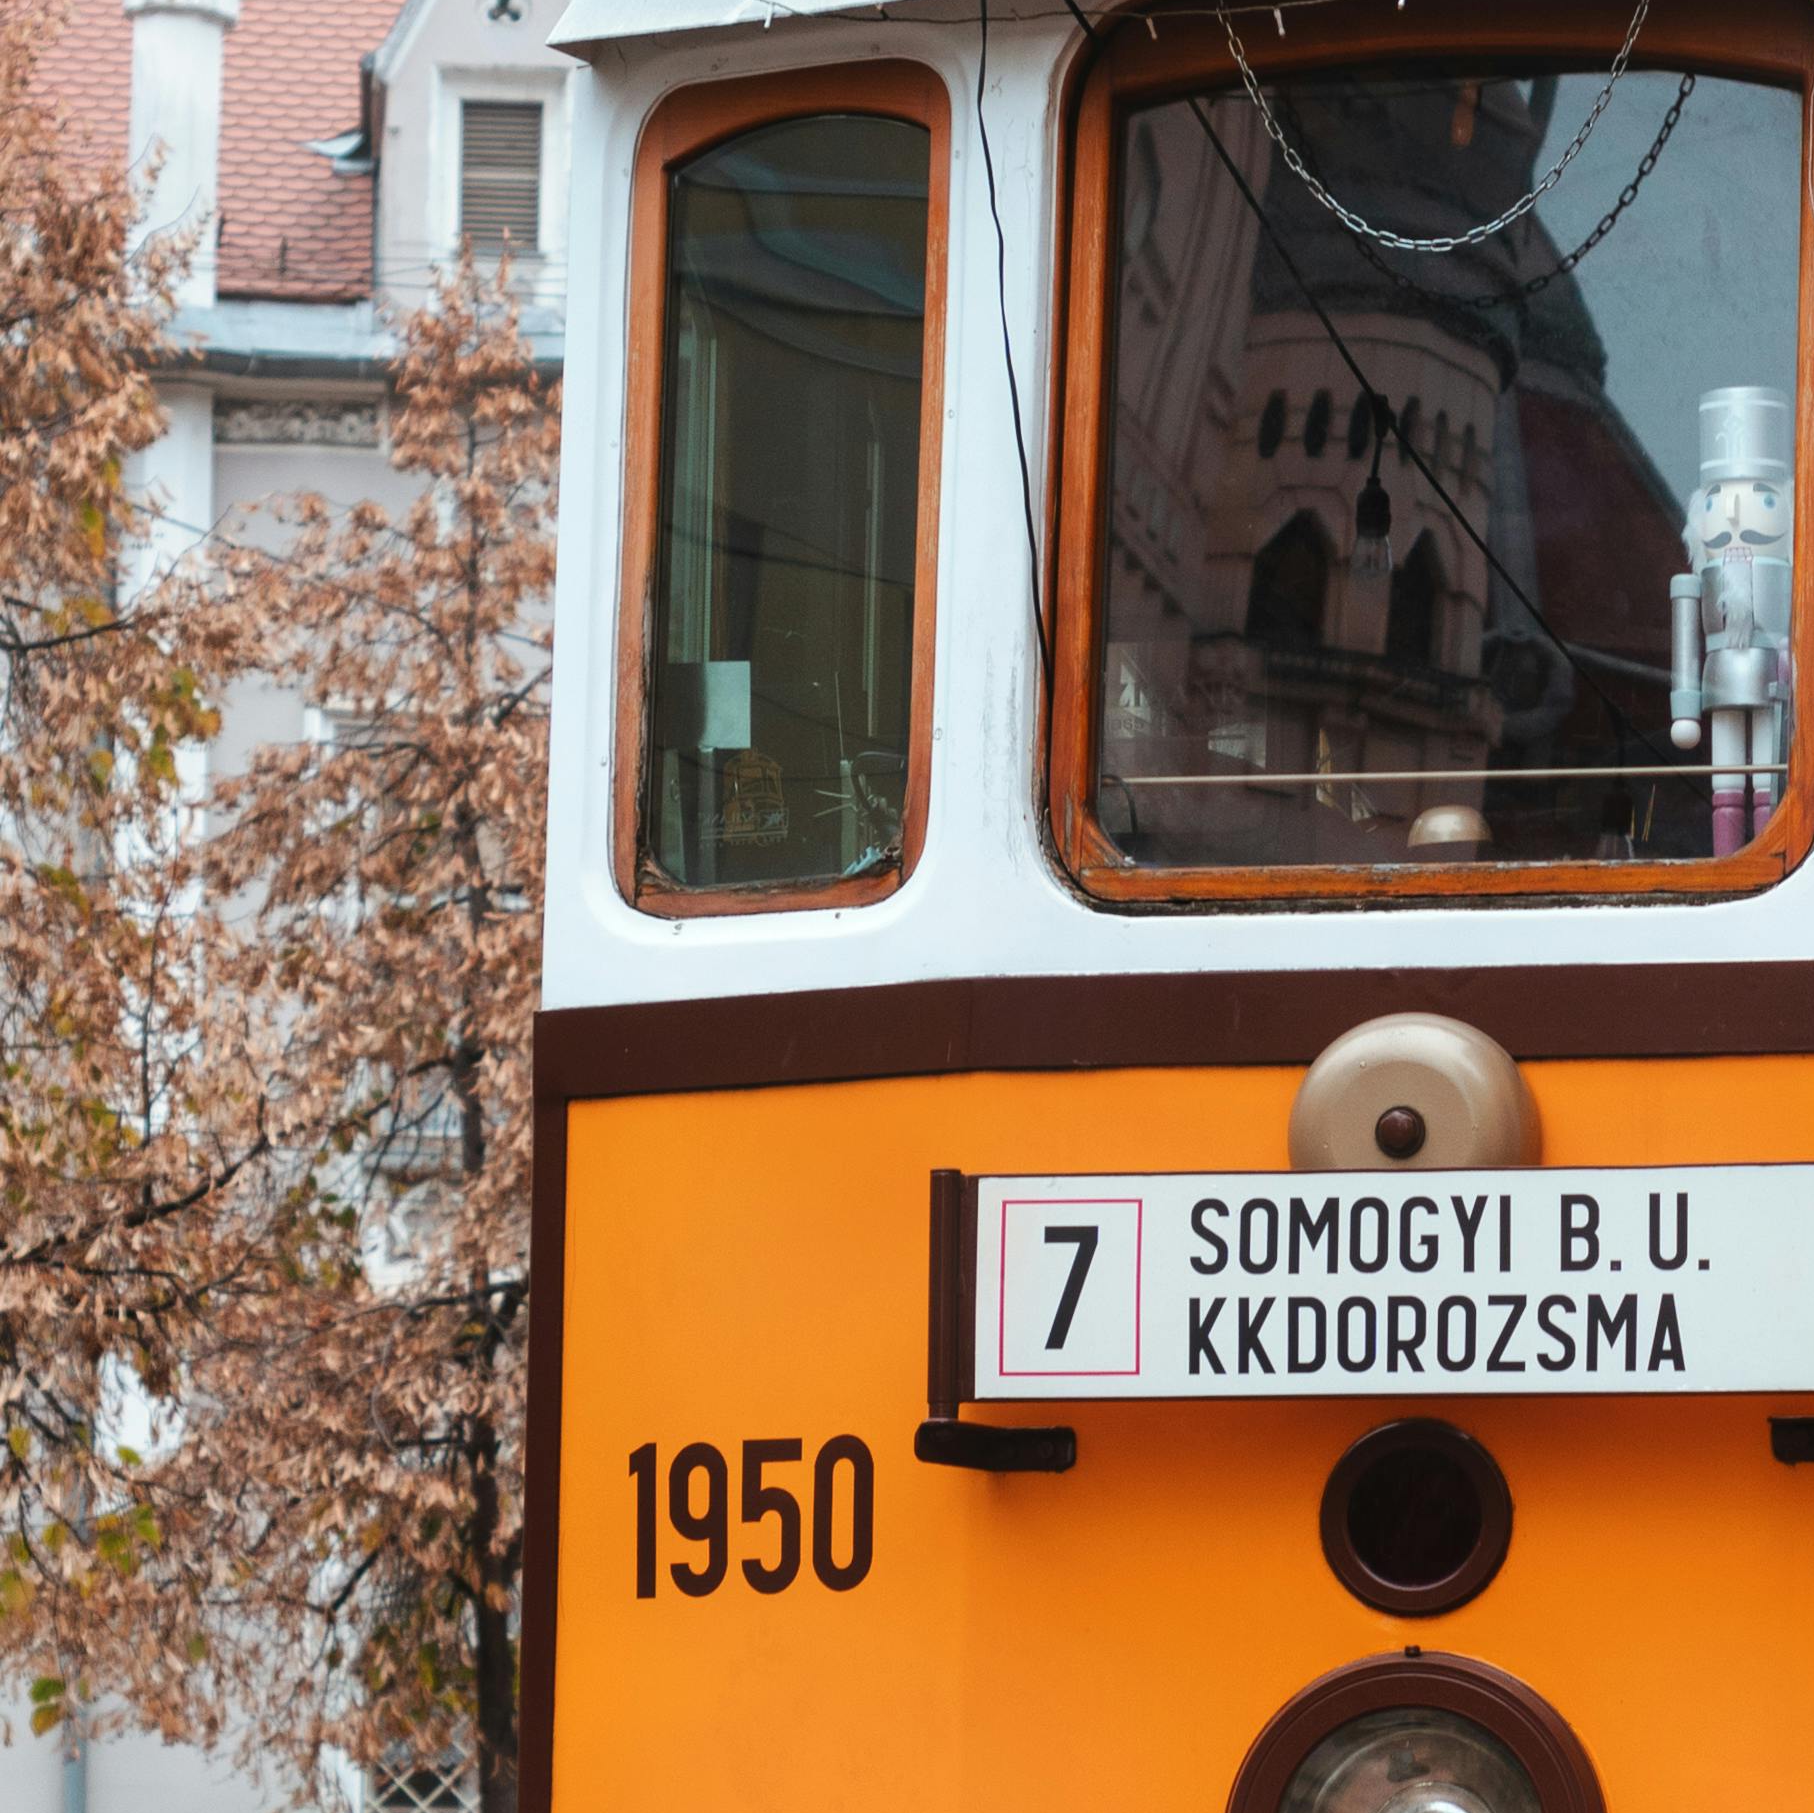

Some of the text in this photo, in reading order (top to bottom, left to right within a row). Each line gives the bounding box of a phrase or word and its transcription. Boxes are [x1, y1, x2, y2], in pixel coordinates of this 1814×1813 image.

[1190, 1194, 1511, 1276] SOMOGYI
[1043, 1225, 1099, 1350] 7
[1189, 1292, 1686, 1376] KKDOROZSMA
[629, 1434, 874, 1599] 1950
